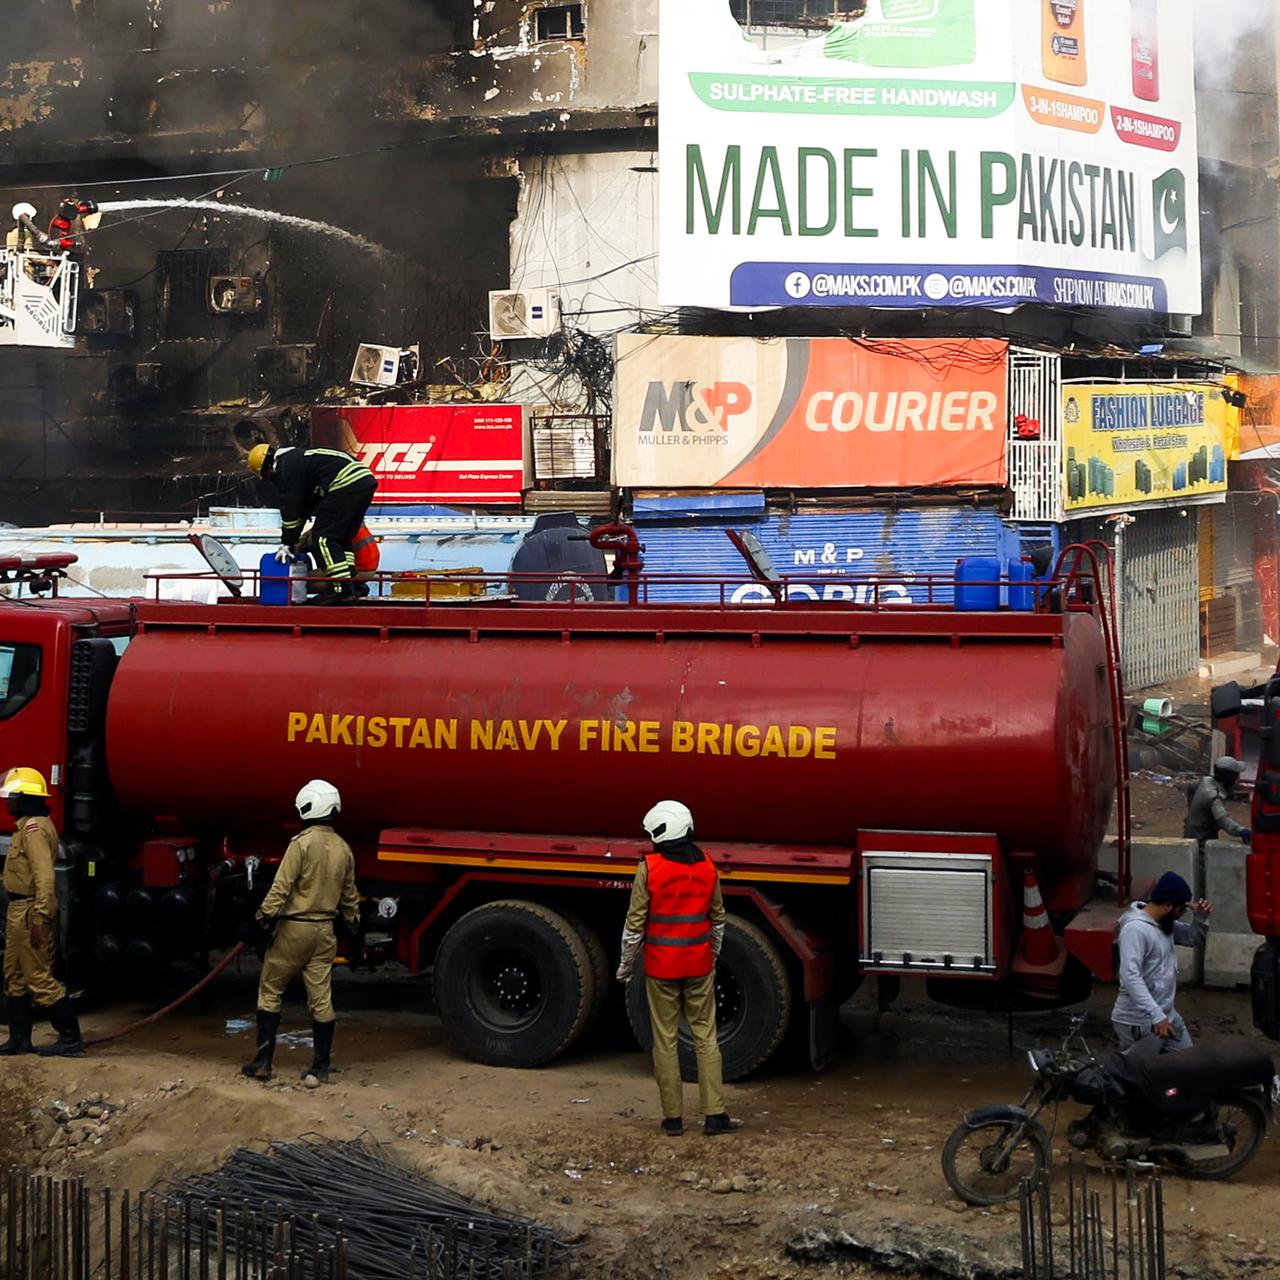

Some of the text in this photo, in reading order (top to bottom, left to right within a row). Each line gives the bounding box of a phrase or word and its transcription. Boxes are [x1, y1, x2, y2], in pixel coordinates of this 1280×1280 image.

[708, 81, 998, 109] SULPHATE-FREE HANDWASH
[685, 143, 1136, 253] MADE IN PAKISTAN
[812, 273, 922, 298] @MAKS.COM.PK
[949, 274, 1038, 299] @MAKS.COM.PK
[24, 304, 51, 334] MAGIRUS
[638, 380, 753, 432] M&P
[805, 390, 996, 432] COURIER
[1090, 394, 1149, 433] FASHION
[1150, 391, 1205, 428] LUGGAGE
[637, 435, 729, 446] MULLER & PHIPPS
[1111, 436, 1145, 452] Wholesale
[1152, 434, 1171, 450] Retail
[358, 442, 434, 472] TCS
[793, 542, 864, 565] M & P
[286, 710, 837, 760] PAKISTAN NAVY FIRE BRIGADE
